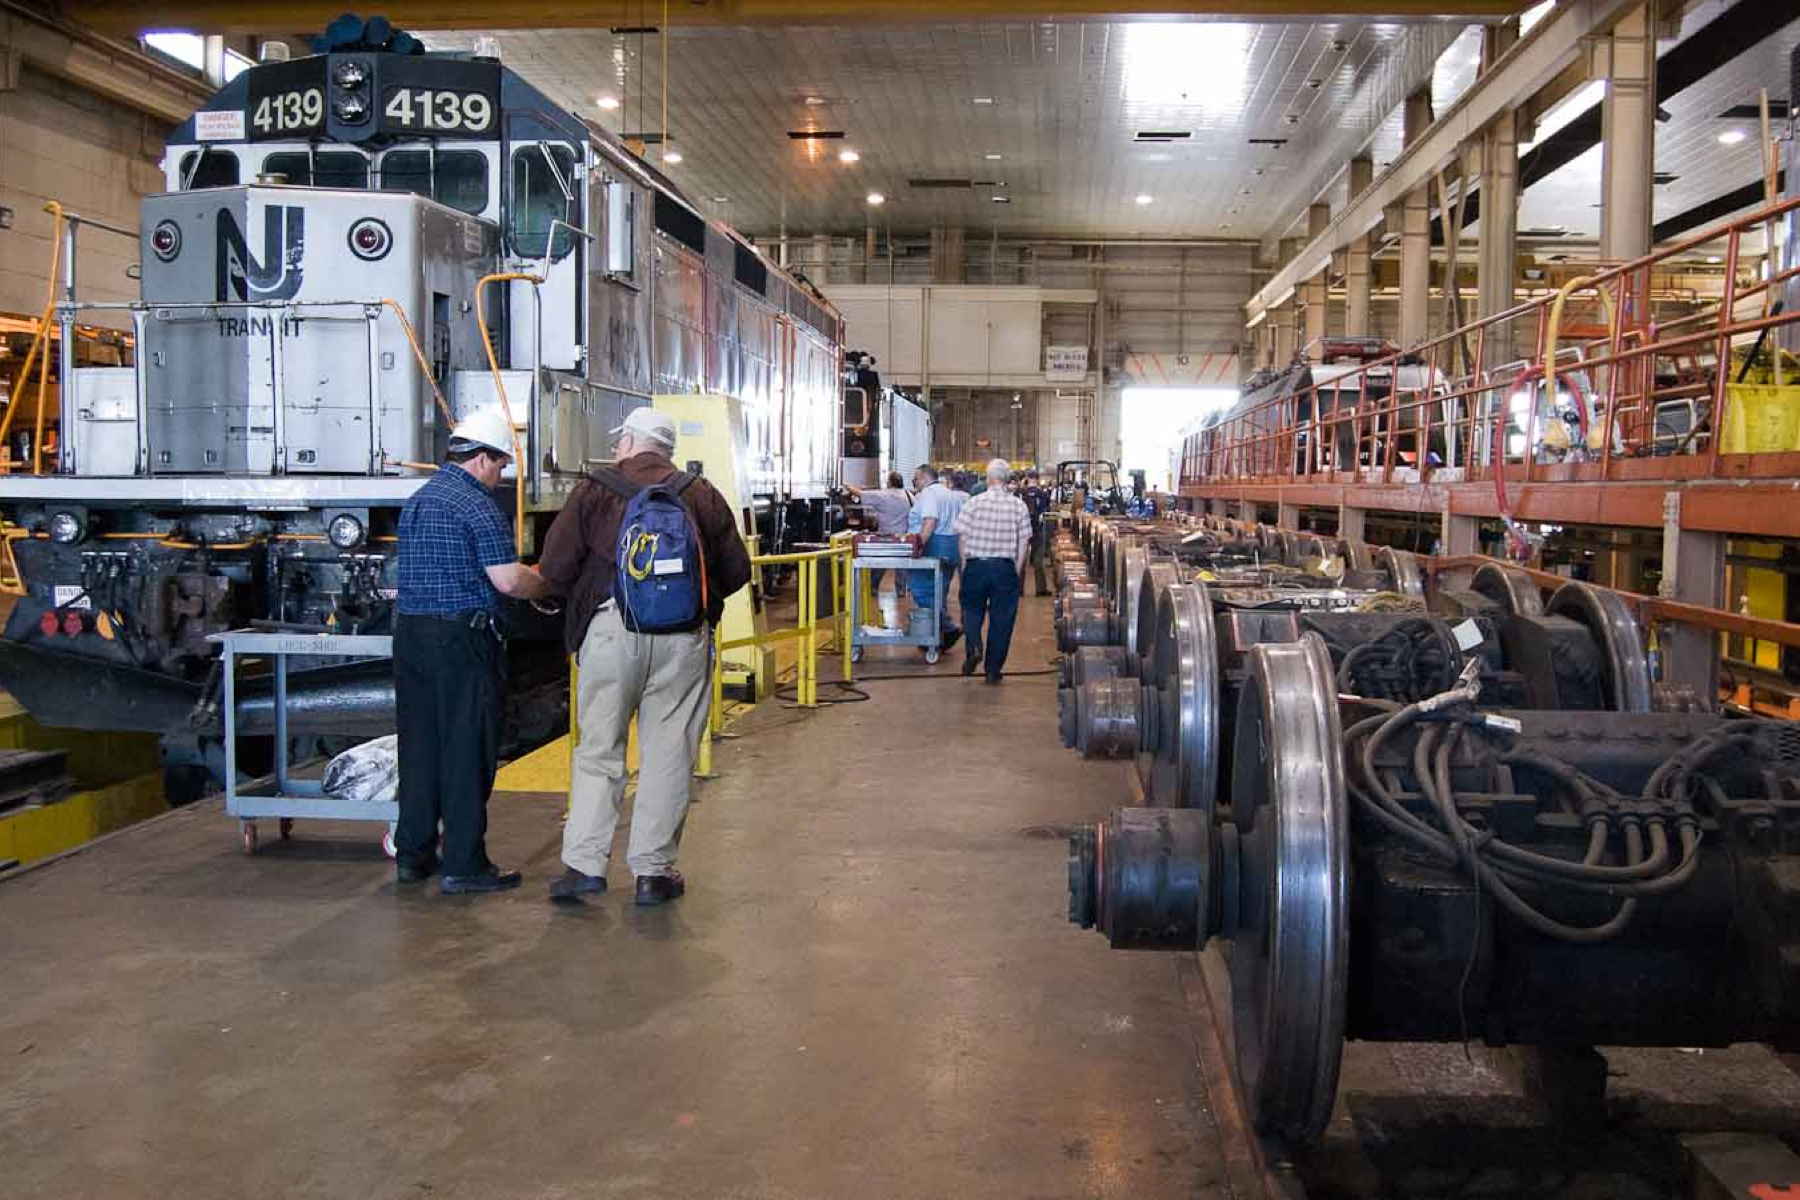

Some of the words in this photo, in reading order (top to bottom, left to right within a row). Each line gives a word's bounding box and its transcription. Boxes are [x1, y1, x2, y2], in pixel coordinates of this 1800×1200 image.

[253, 88, 323, 132] 4139
[385, 88, 492, 132] 4139
[217, 317, 304, 337] TRANIT
